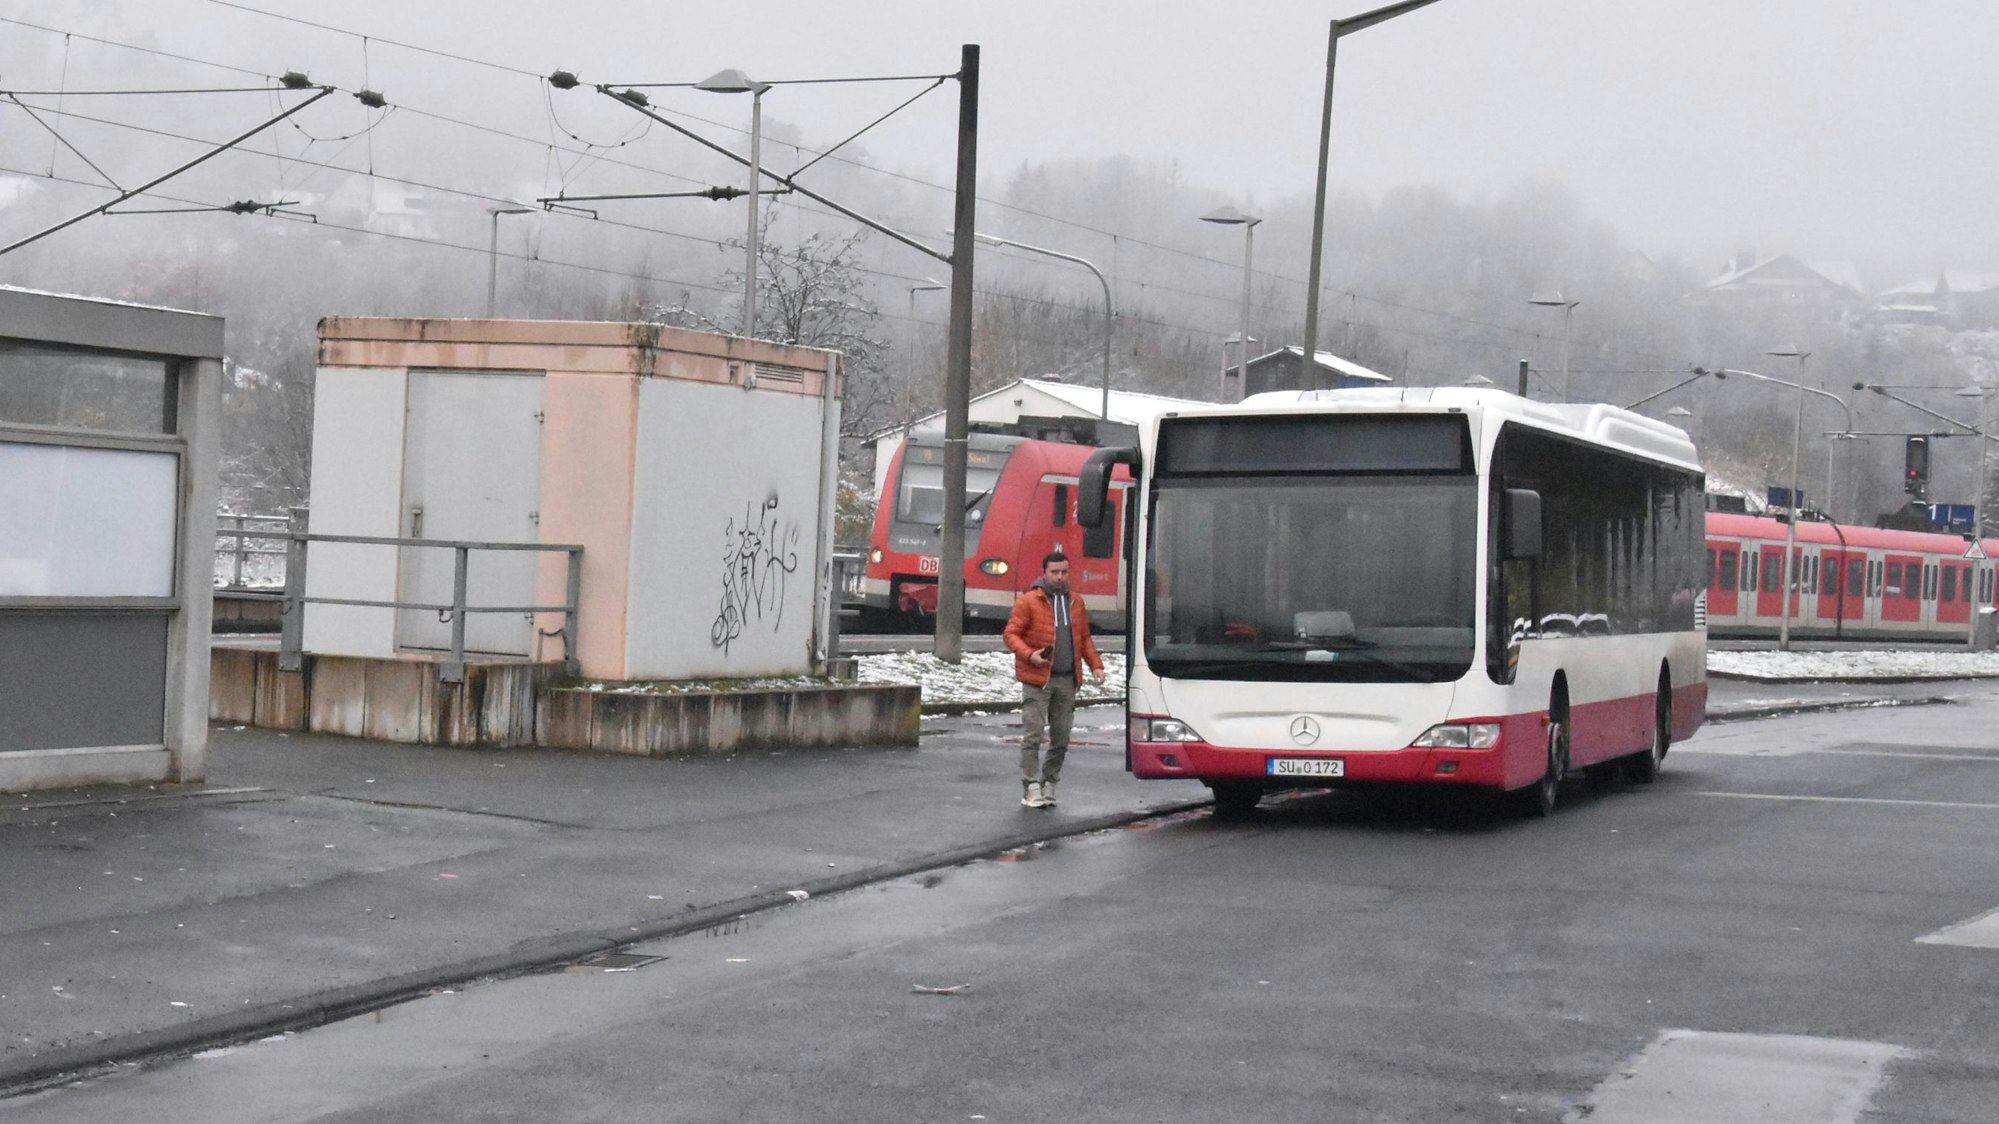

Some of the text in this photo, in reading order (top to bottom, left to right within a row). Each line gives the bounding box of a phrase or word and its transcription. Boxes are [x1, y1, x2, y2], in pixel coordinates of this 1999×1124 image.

[1928, 503, 1937, 521] 1
[921, 559, 938, 571] DB
[1278, 760, 1295, 773] SU
[1315, 761, 1338, 774] 172
